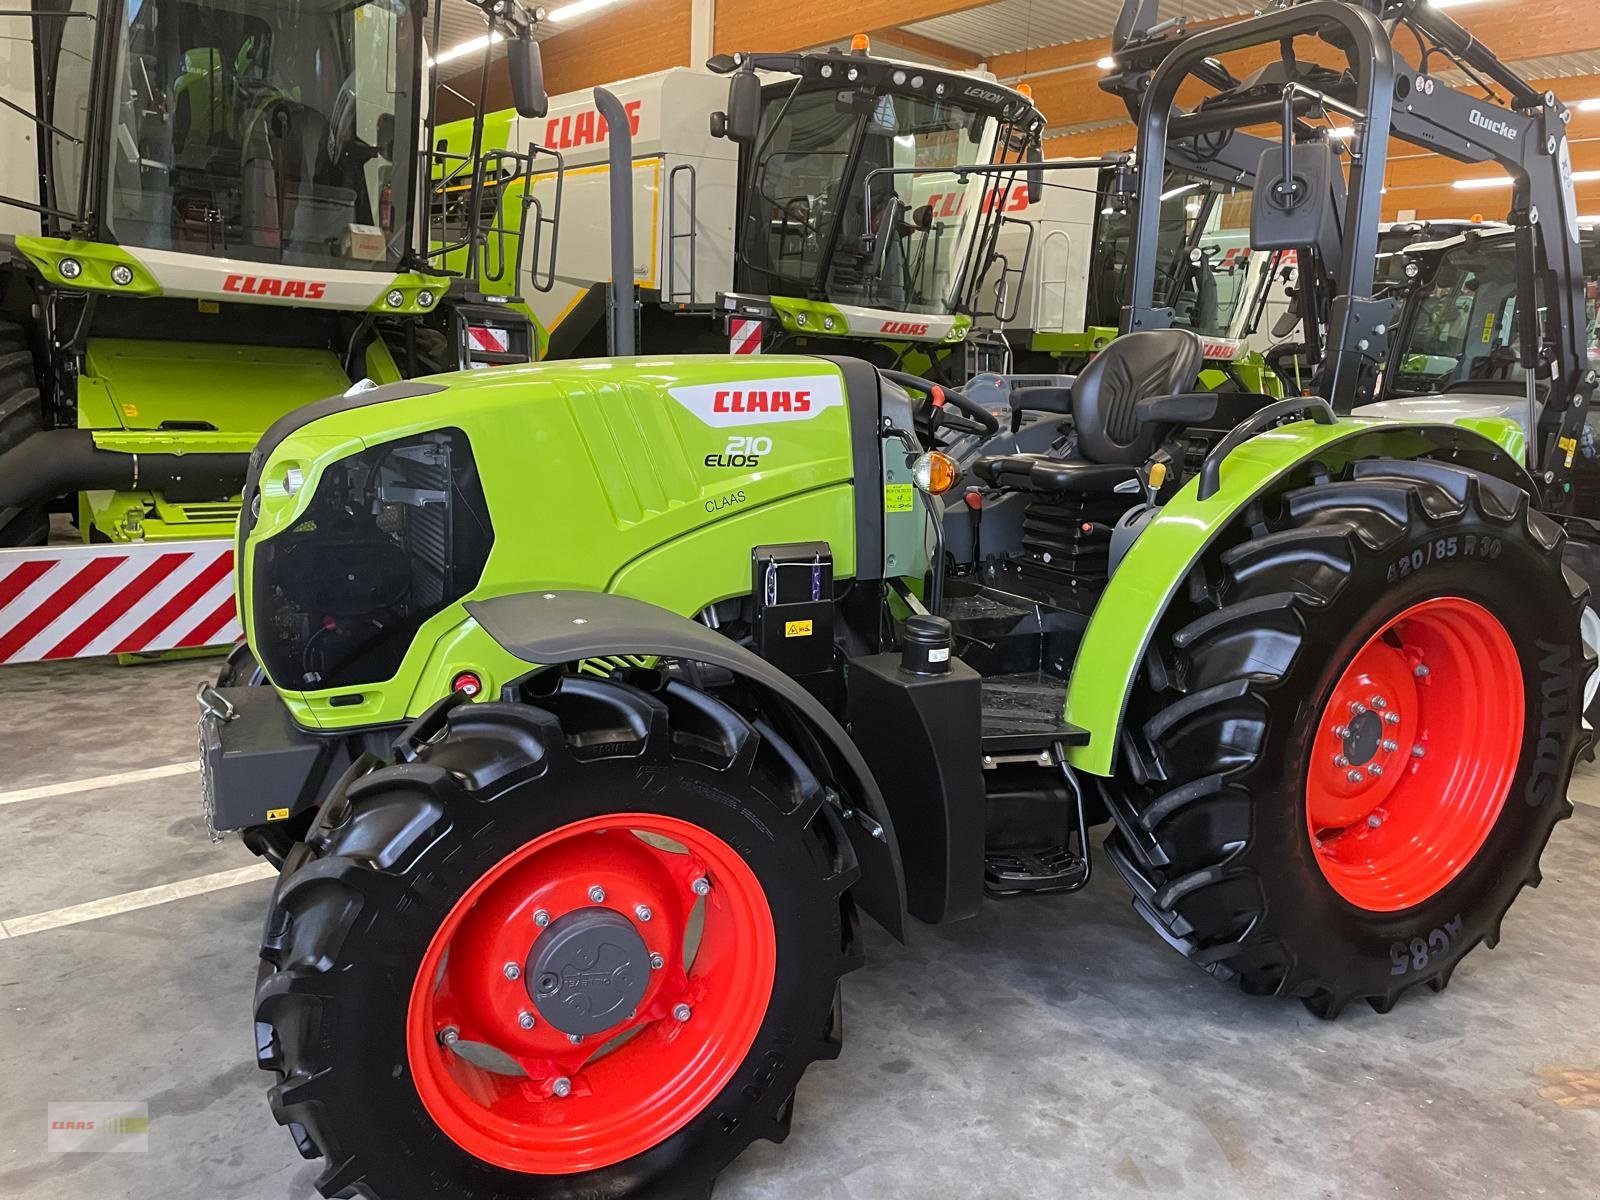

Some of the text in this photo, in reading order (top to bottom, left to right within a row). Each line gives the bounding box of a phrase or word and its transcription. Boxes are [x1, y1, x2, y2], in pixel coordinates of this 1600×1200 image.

[963, 86, 1004, 104] LEXION
[1469, 109, 1517, 140] Quicke
[223, 274, 326, 299] CLAAS
[880, 321, 929, 336] CLAAS
[713, 391, 811, 413] CLAAS
[725, 436, 773, 455] 210
[704, 454, 759, 467] ELIOS
[705, 490, 746, 512] CLAAS
[1389, 913, 1464, 976] AG85
